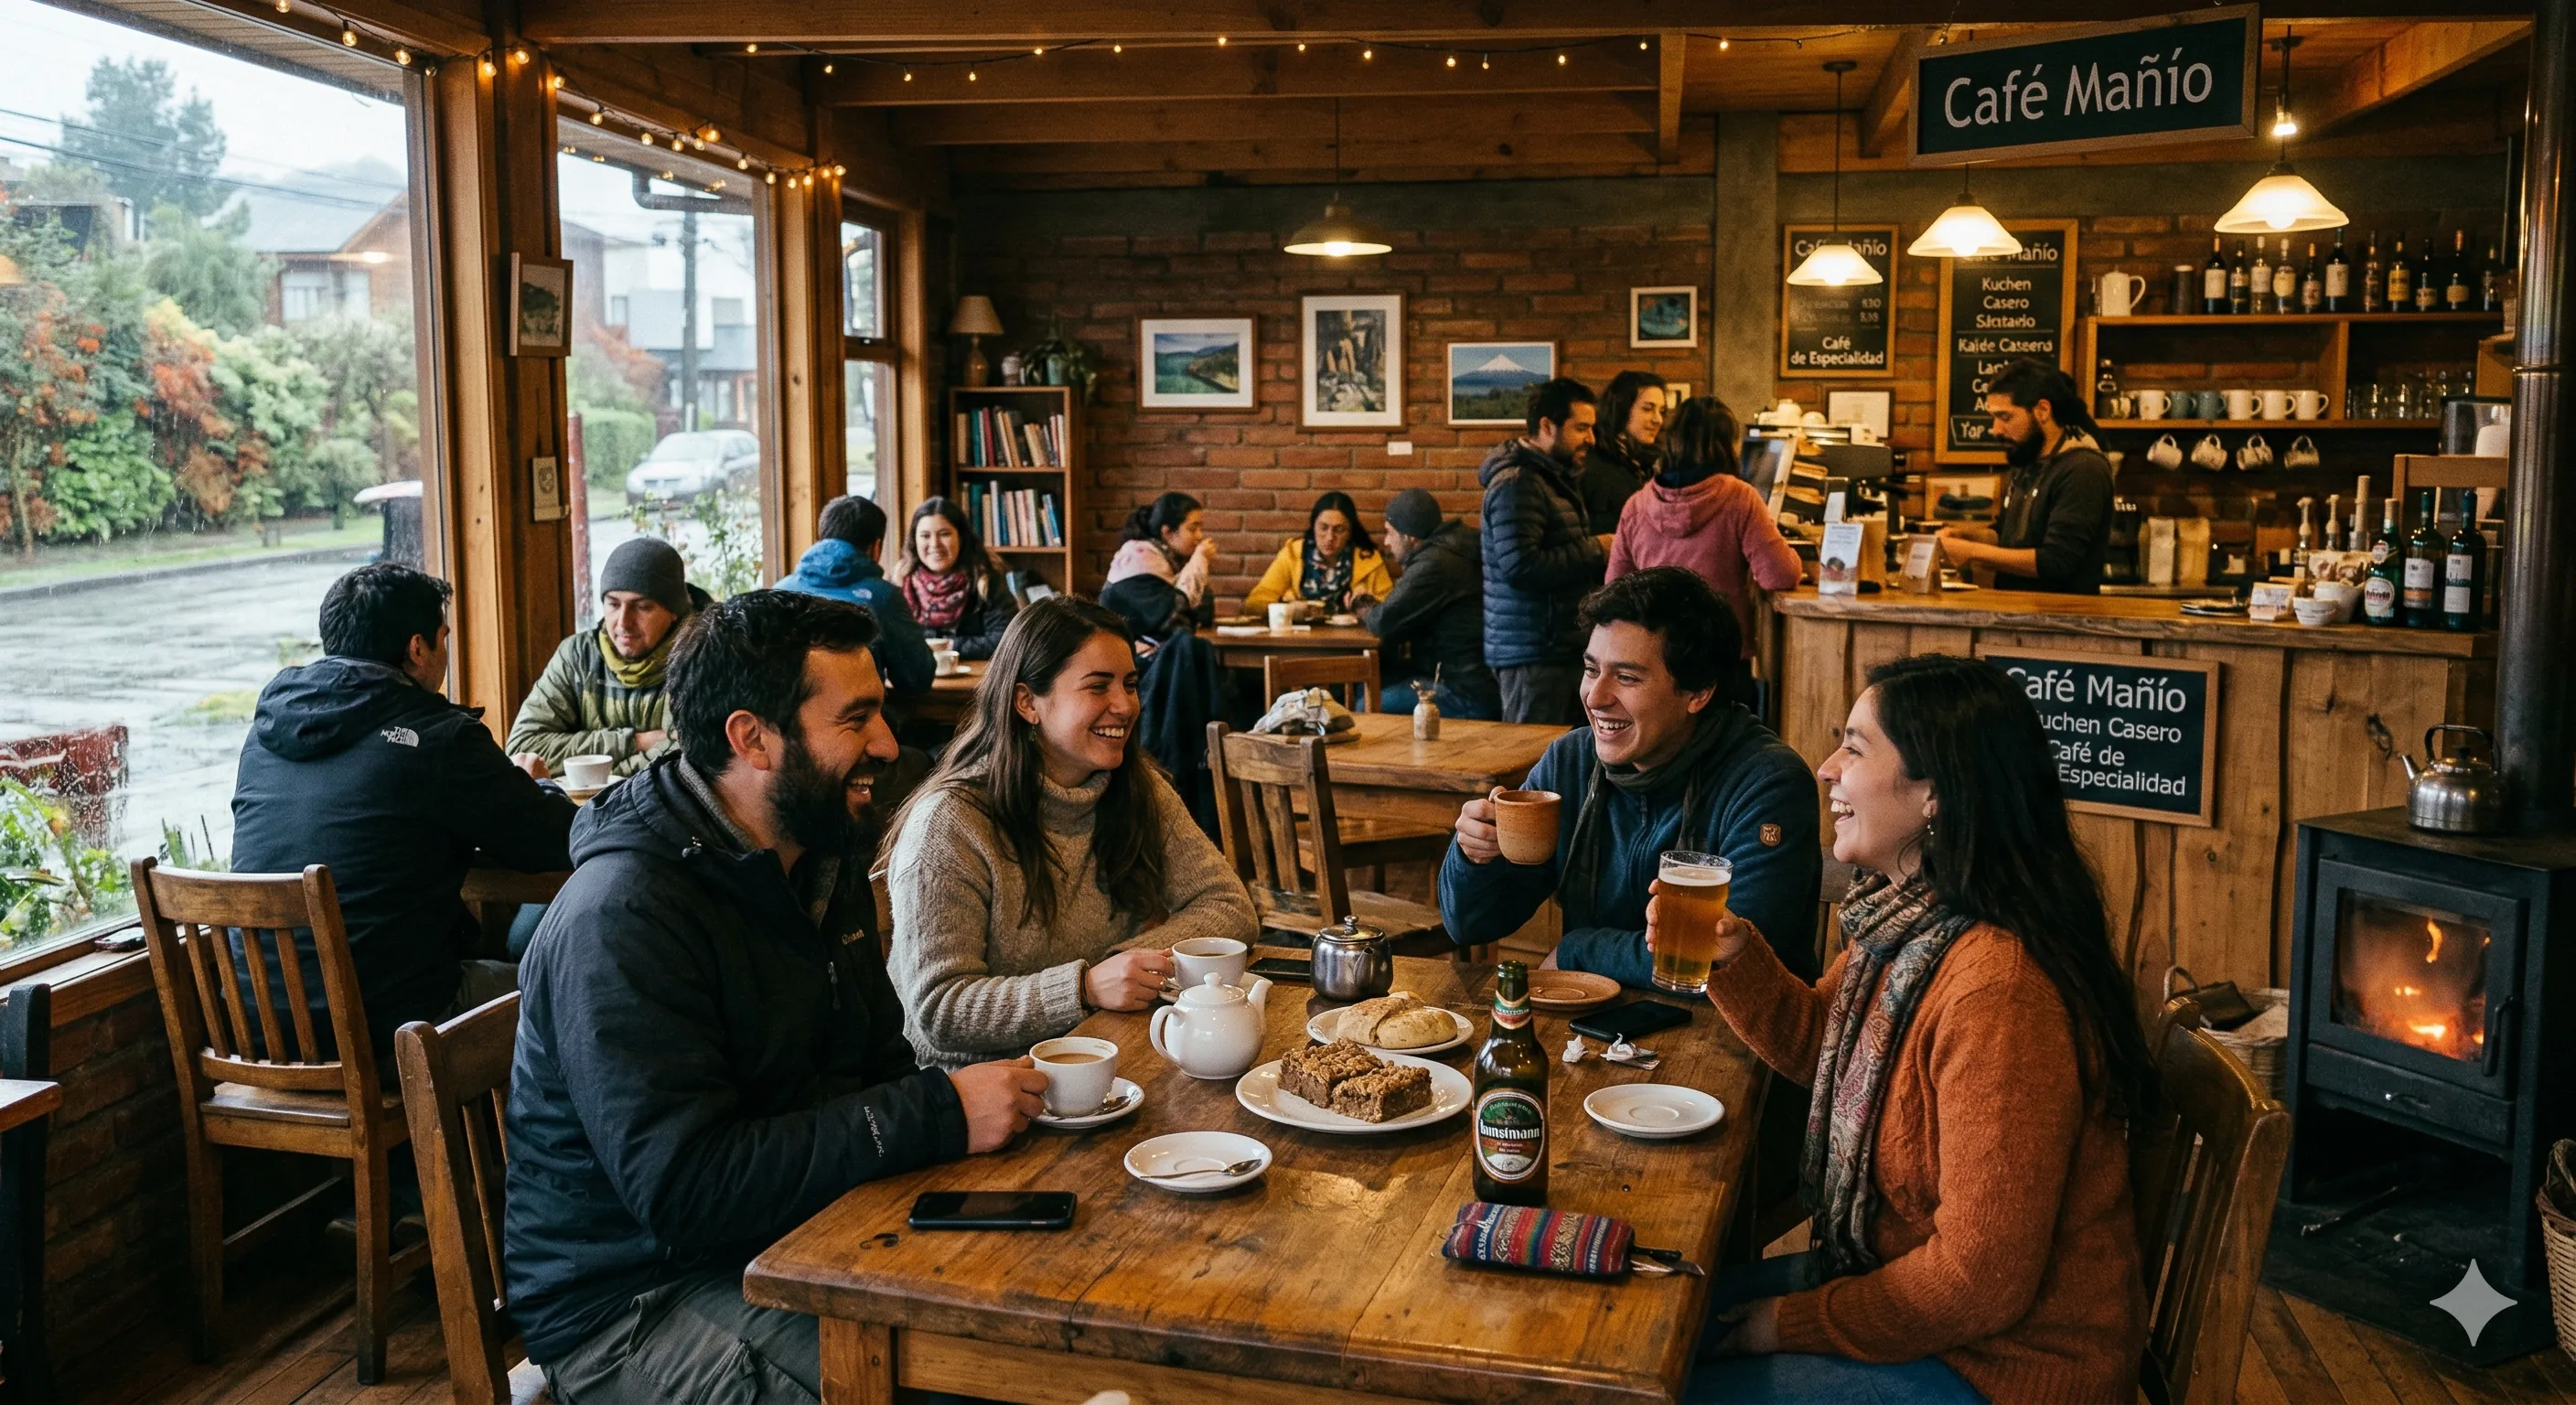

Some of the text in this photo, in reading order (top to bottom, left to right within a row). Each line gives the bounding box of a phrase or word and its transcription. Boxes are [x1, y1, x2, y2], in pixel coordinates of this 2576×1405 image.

[1944, 48, 2213, 128] Café Mañío
[1981, 276, 2032, 291] Kuchen
[1983, 295, 2030, 310] Casero
[1822, 336, 1852, 350] Café
[1790, 350, 1884, 368] de Especialidad
[2087, 674, 2186, 713] Mañío
[2038, 712, 2182, 743] uchen Casero
[2098, 745, 2125, 767] de
[2058, 763, 2186, 796] Especialidad
